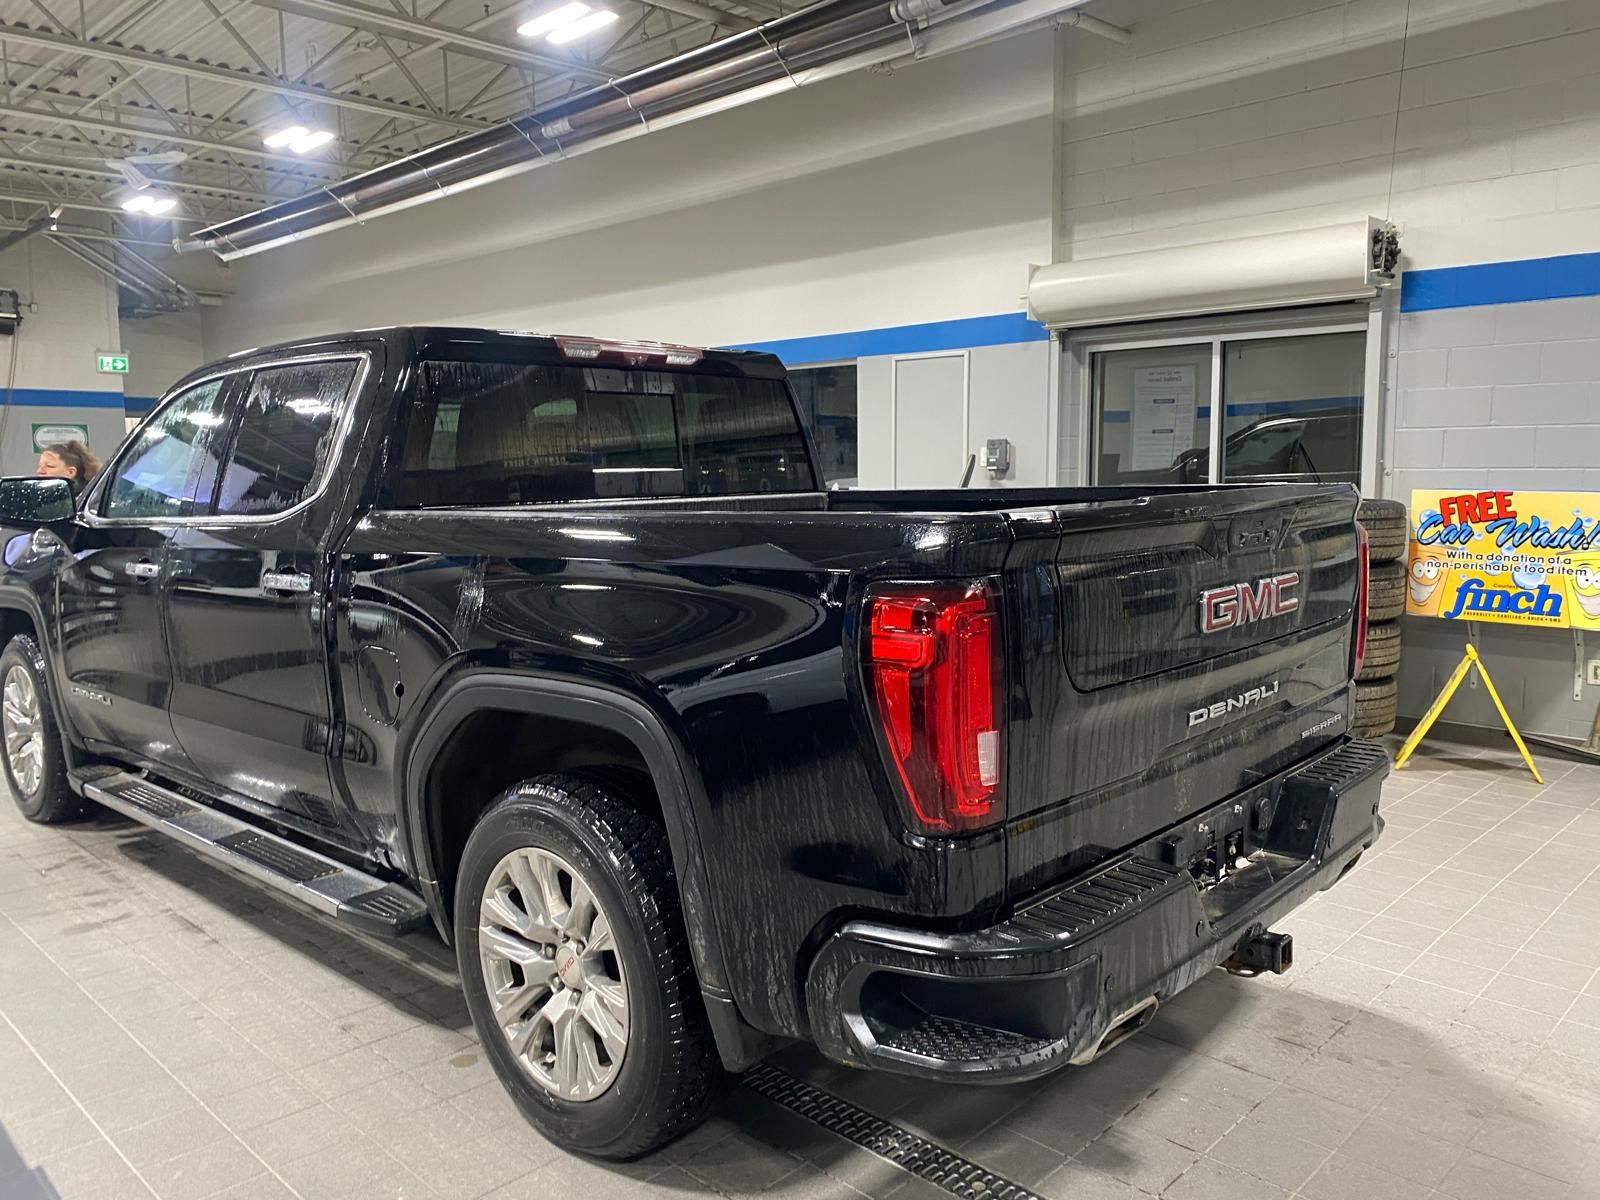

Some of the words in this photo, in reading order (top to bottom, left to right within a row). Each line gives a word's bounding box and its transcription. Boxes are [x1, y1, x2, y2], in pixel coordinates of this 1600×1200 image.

[1439, 491, 1517, 528] FREE
[1417, 513, 1475, 545] Car
[1427, 561, 1521, 573] non-perishable
[1524, 564, 1554, 574] food
[1557, 567, 1587, 576] item
[1446, 551, 1472, 560] With
[1486, 553, 1540, 563] donation
[1548, 556, 1560, 564] of
[1201, 572, 1300, 634] GMC
[1444, 578, 1562, 619] finch
[1187, 680, 1279, 726] DENALI
[1301, 713, 1342, 739] SIERRA
